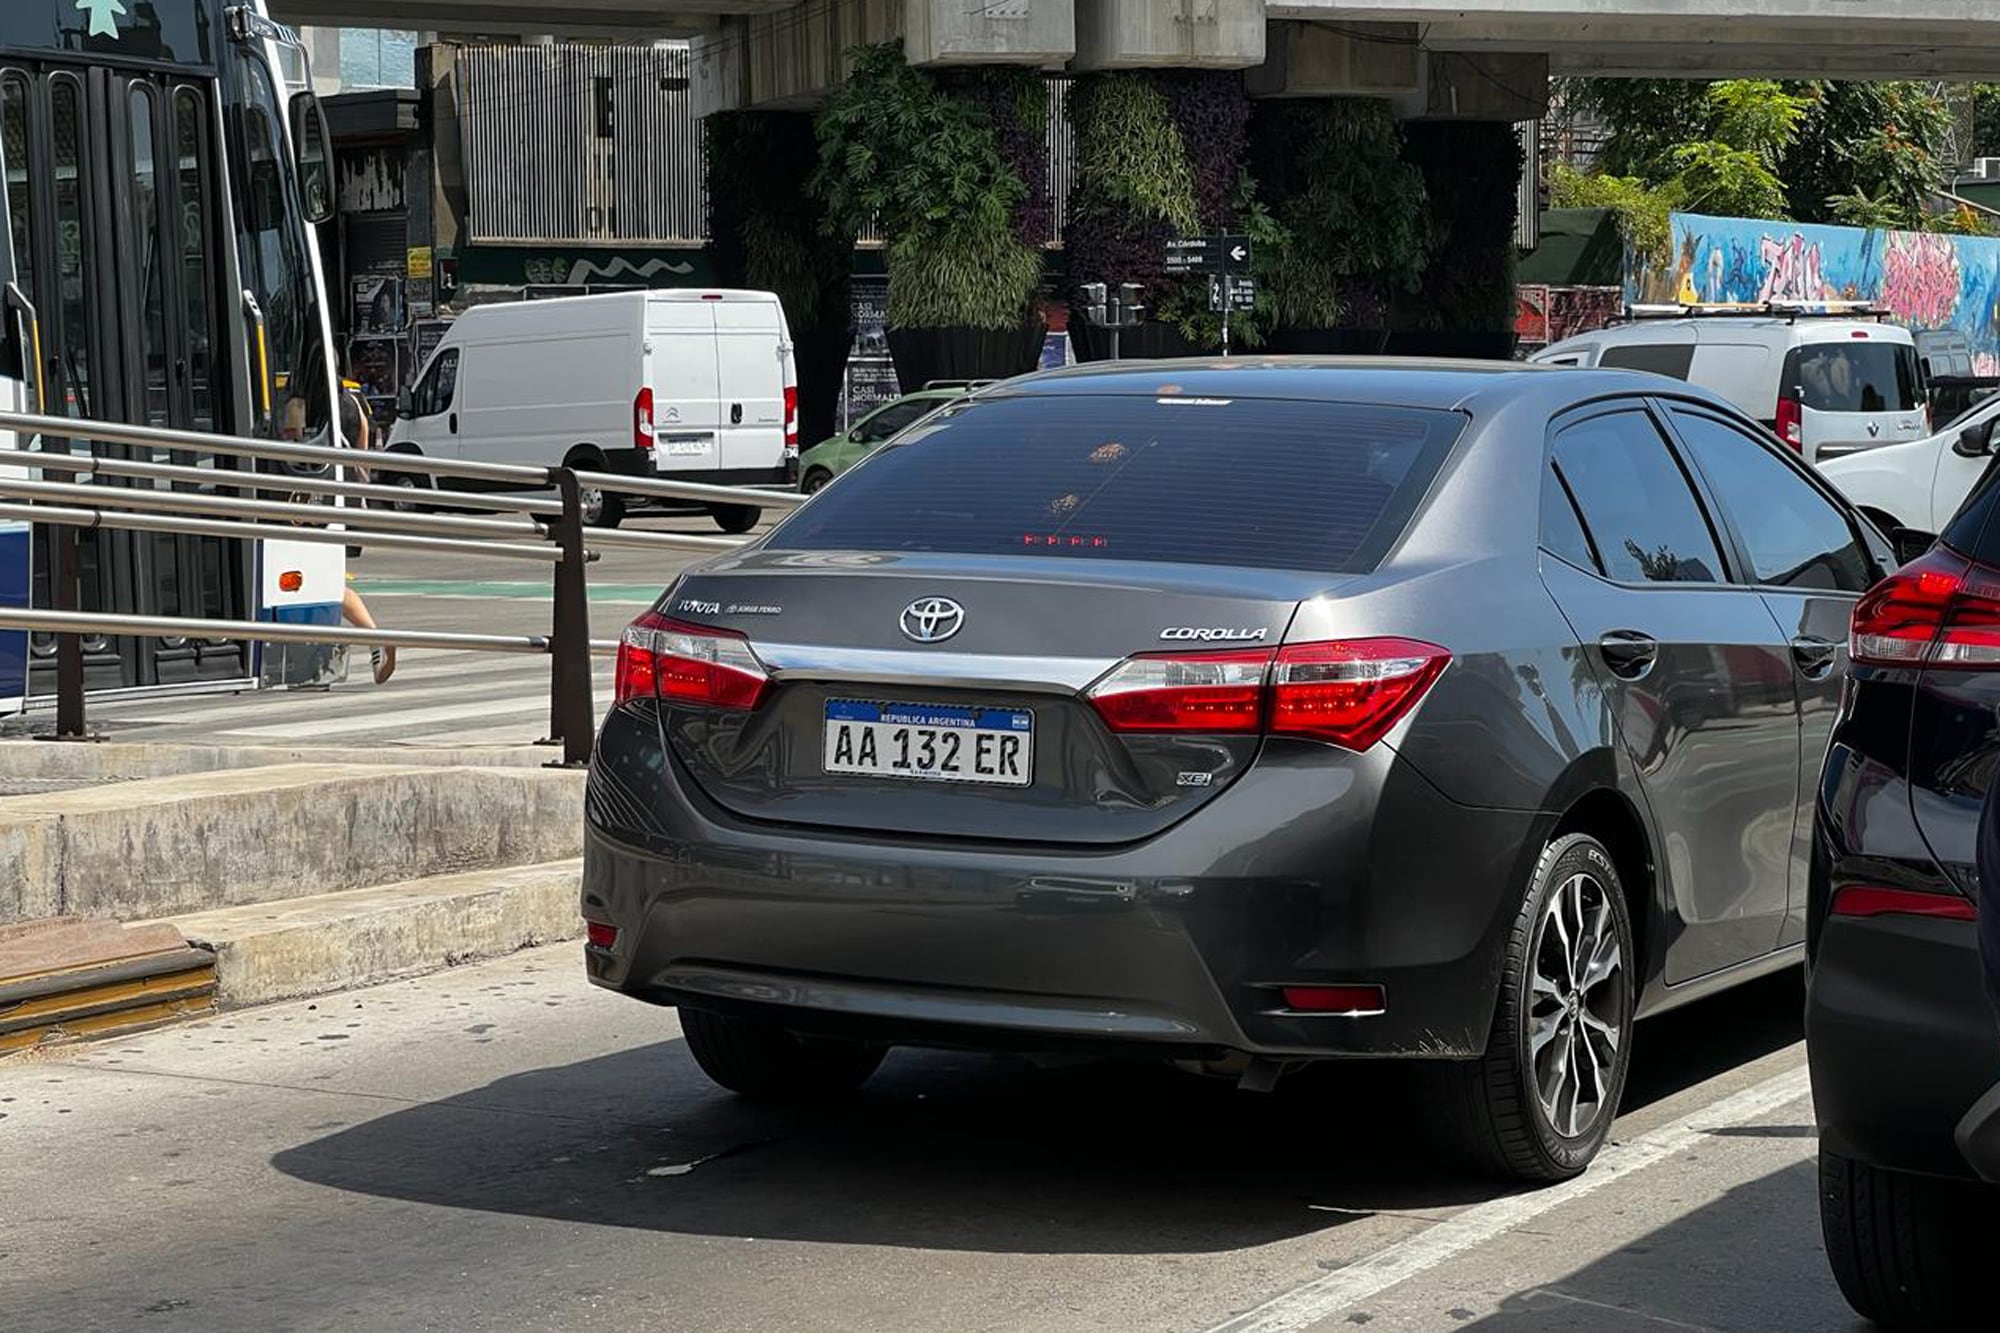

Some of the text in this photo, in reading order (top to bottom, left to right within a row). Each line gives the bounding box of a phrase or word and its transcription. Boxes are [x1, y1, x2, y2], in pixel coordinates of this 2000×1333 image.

[853, 386, 875, 394] CASI
[678, 600, 720, 614] TOYOTA
[1160, 627, 1268, 641] COROLLA
[928, 717, 976, 728] ARGENTINA
[834, 725, 1020, 777] AA 132 ER
